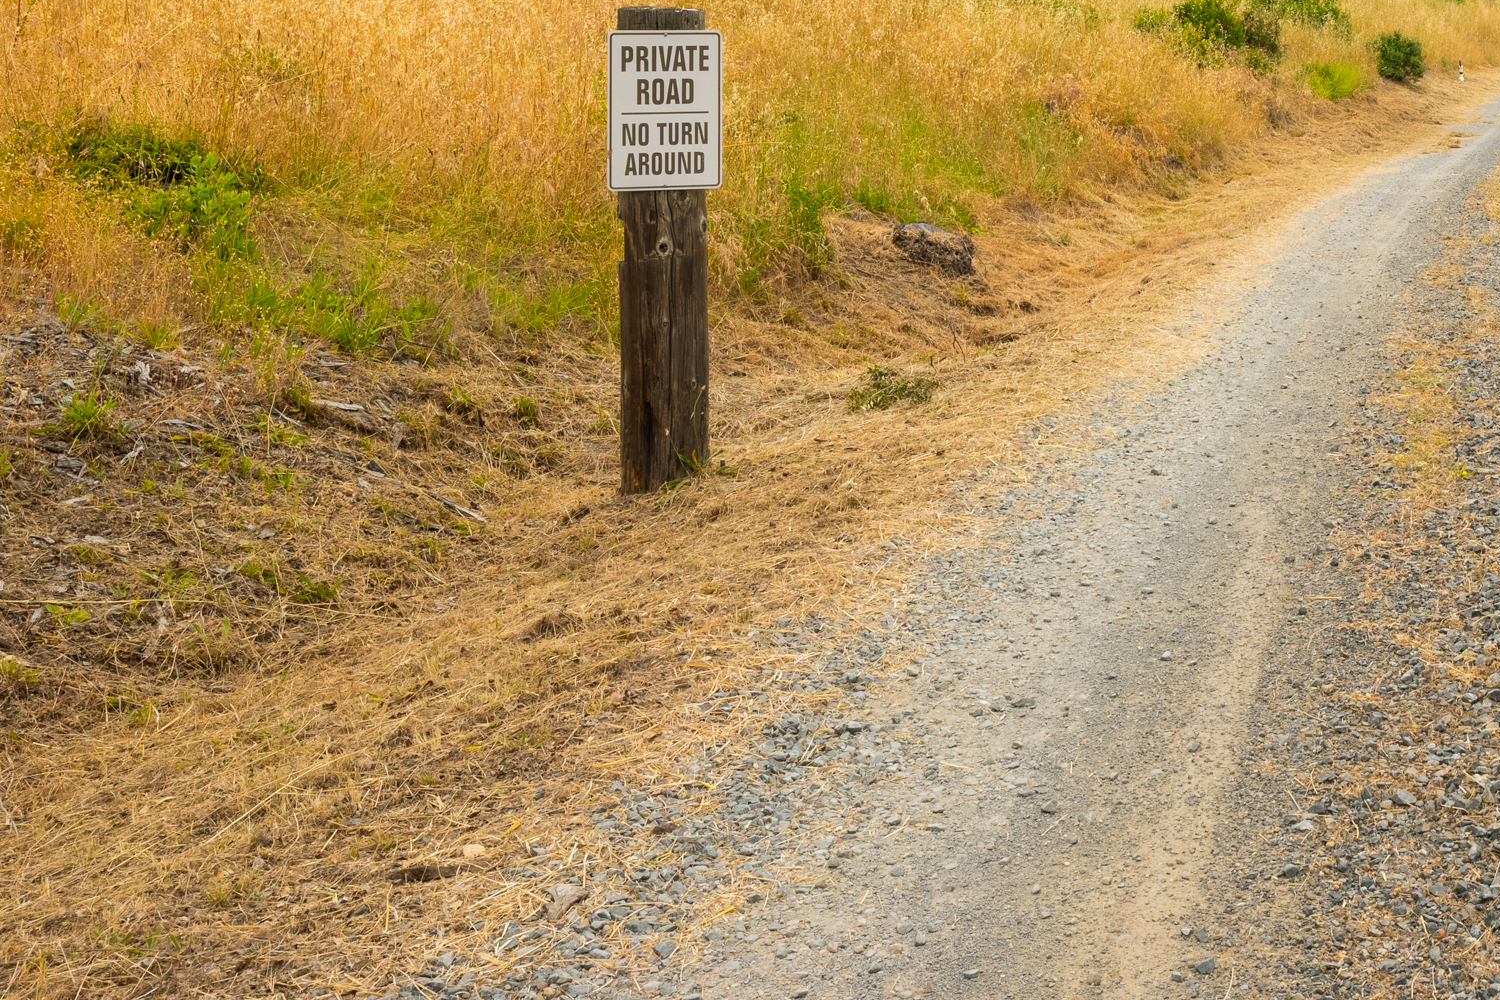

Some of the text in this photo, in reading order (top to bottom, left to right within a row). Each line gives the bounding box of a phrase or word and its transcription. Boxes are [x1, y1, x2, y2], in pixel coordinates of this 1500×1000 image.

[621, 45, 710, 72] PRIVATE
[636, 78, 694, 105] ROAD
[622, 121, 708, 146] NO TURN
[624, 151, 705, 176] AROUND
